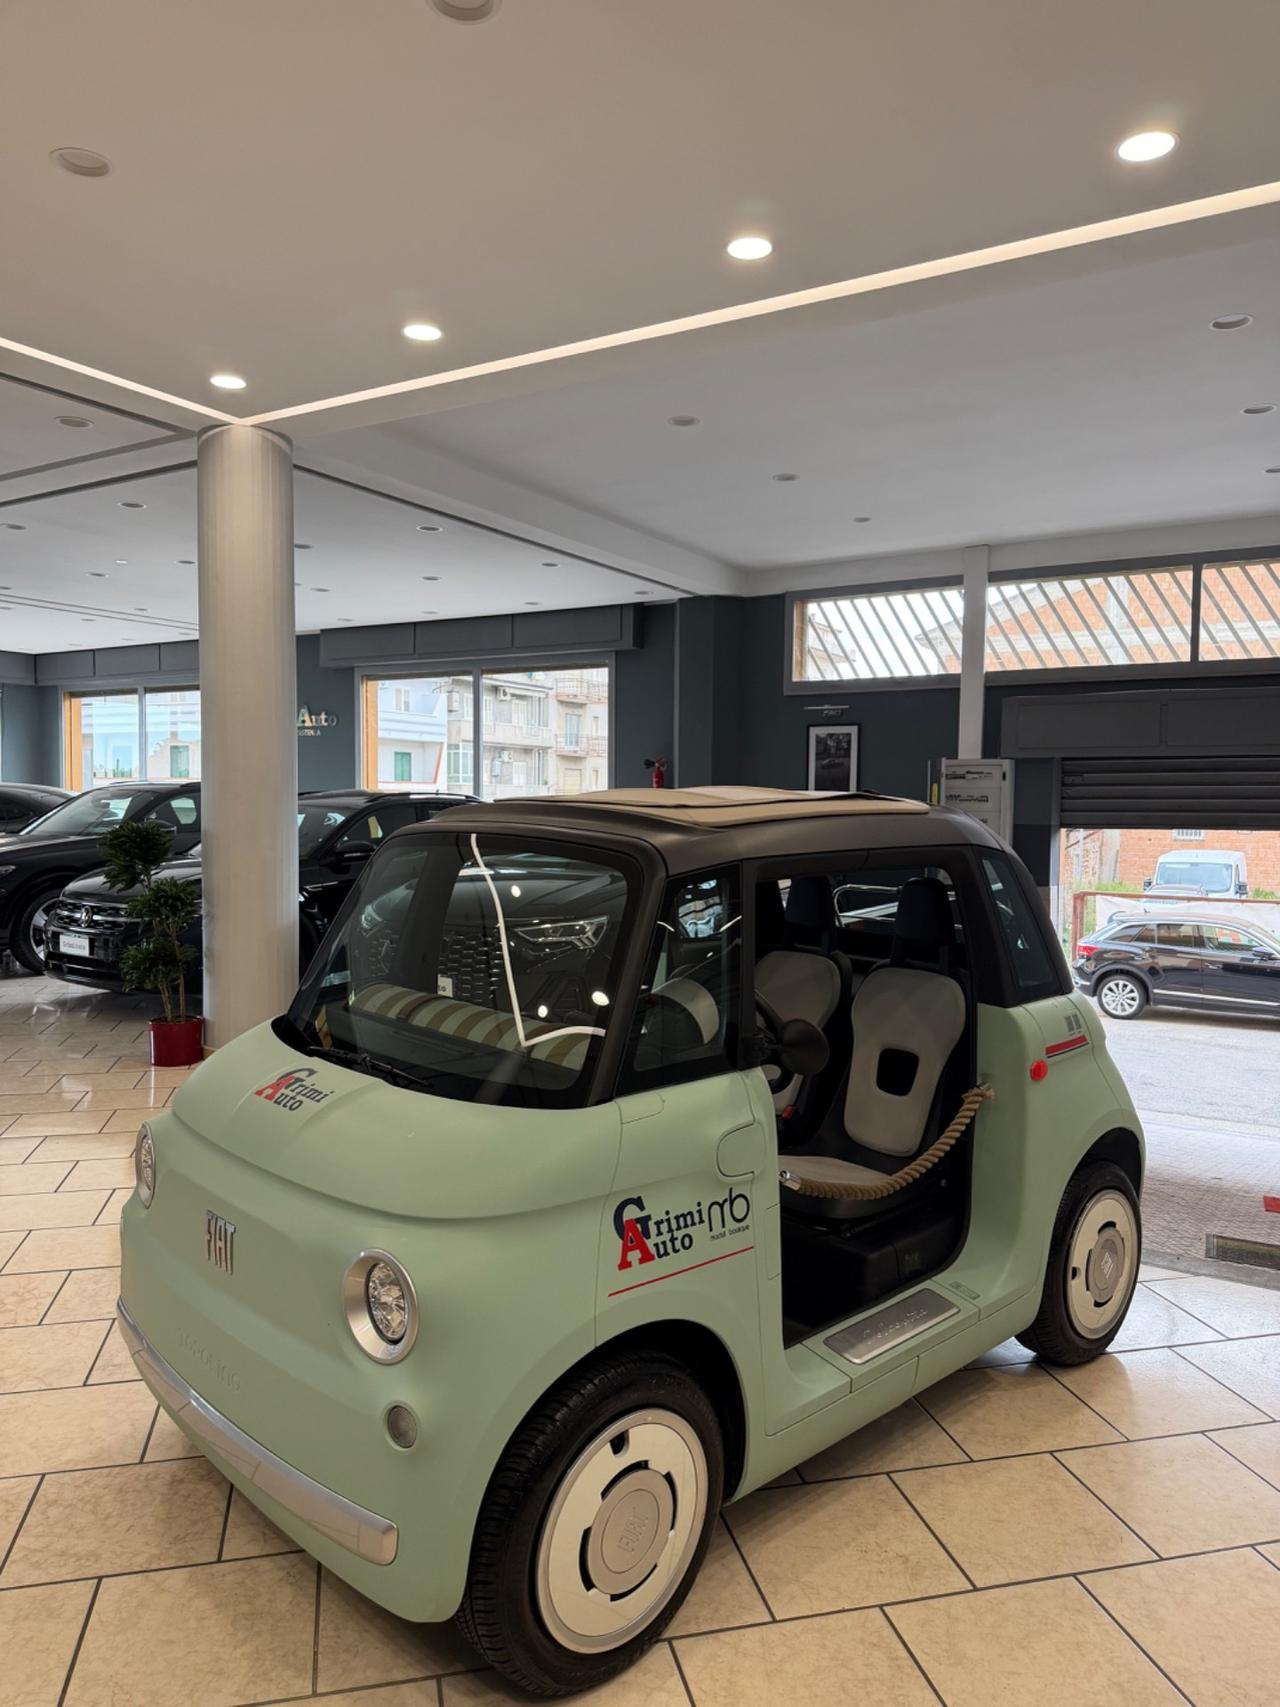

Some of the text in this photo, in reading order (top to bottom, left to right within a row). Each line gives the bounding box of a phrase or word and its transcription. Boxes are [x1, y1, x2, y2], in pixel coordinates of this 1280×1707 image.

[255, 1073, 304, 1111] Auto
[276, 1068, 335, 1103] Grimi
[613, 1196, 705, 1241] Grimi
[206, 1209, 237, 1276] FIAT
[617, 1218, 693, 1271] Auto
